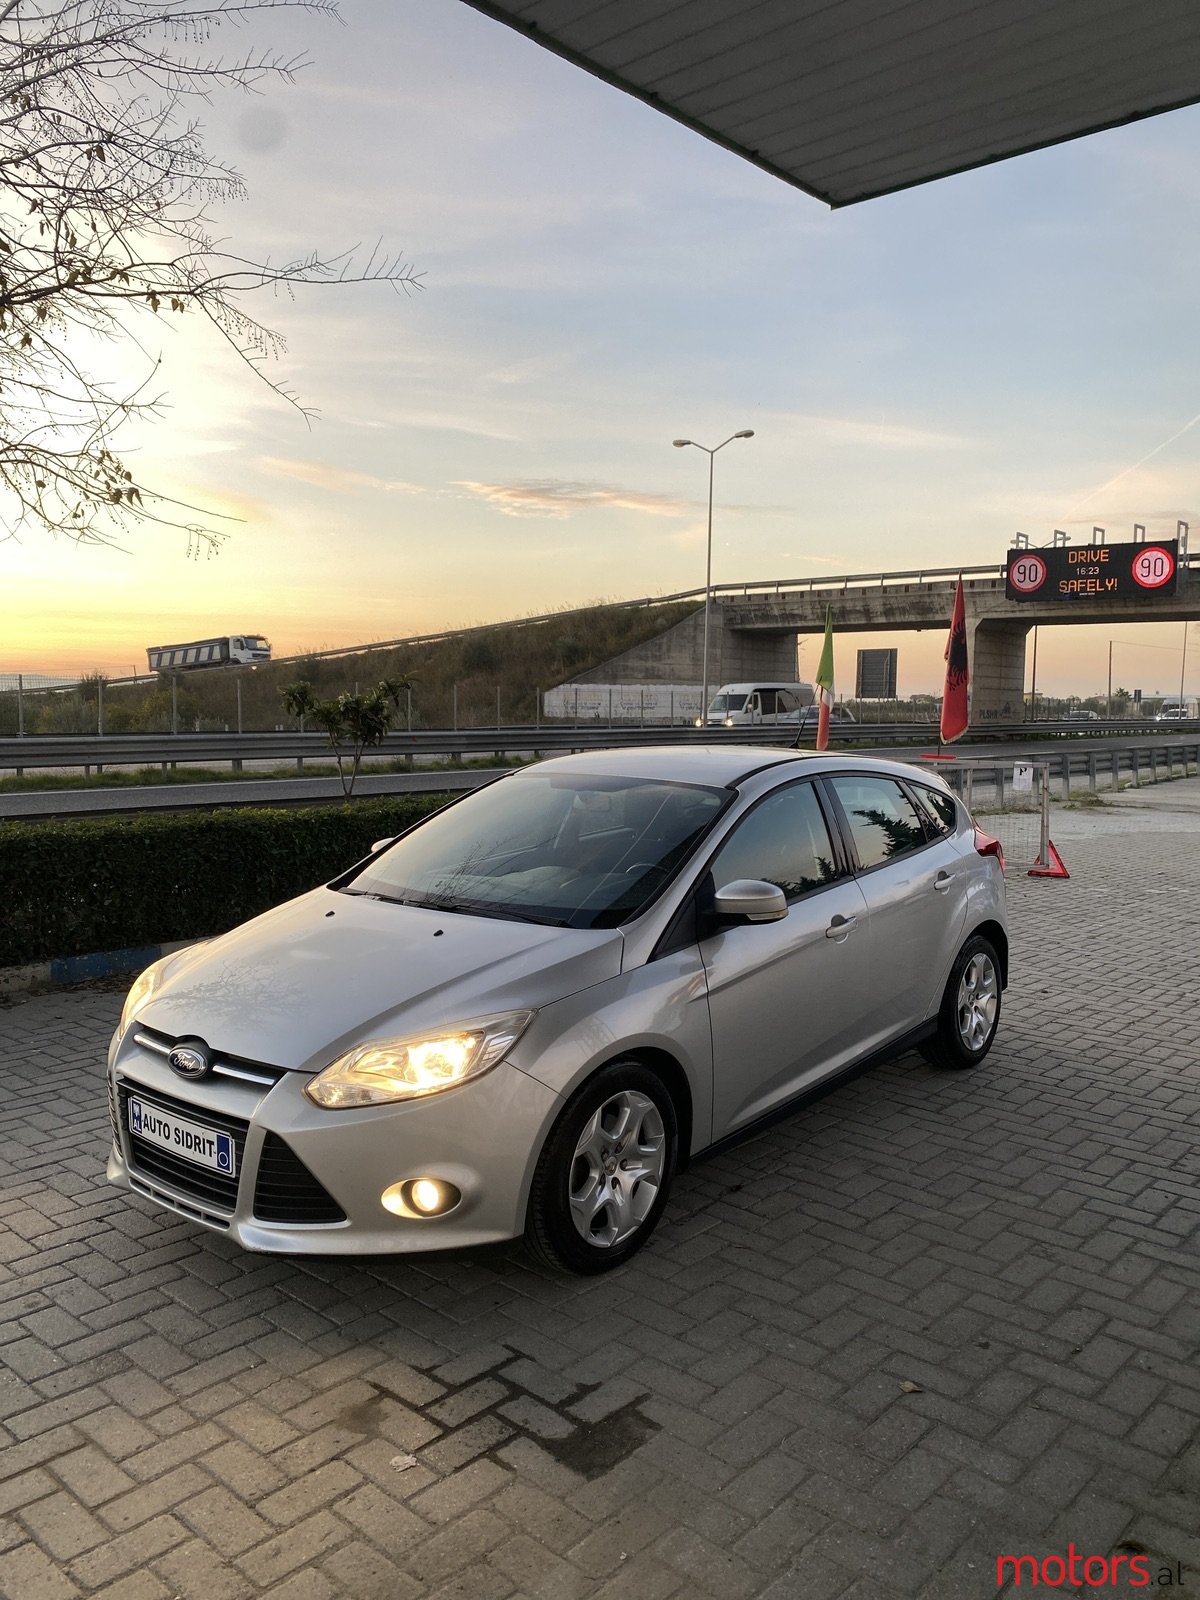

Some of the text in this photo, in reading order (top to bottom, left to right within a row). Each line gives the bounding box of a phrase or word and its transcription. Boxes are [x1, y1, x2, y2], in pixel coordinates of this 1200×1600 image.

[1068, 549, 1110, 564] DRIVE
[1017, 564, 1038, 583] 90
[1076, 566, 1100, 575] 16:23
[1140, 557, 1164, 578] 90
[1059, 578, 1118, 592] SAFELY!
[173, 1052, 196, 1070] Ford
[143, 1113, 215, 1157] AUTO SIDRIT
